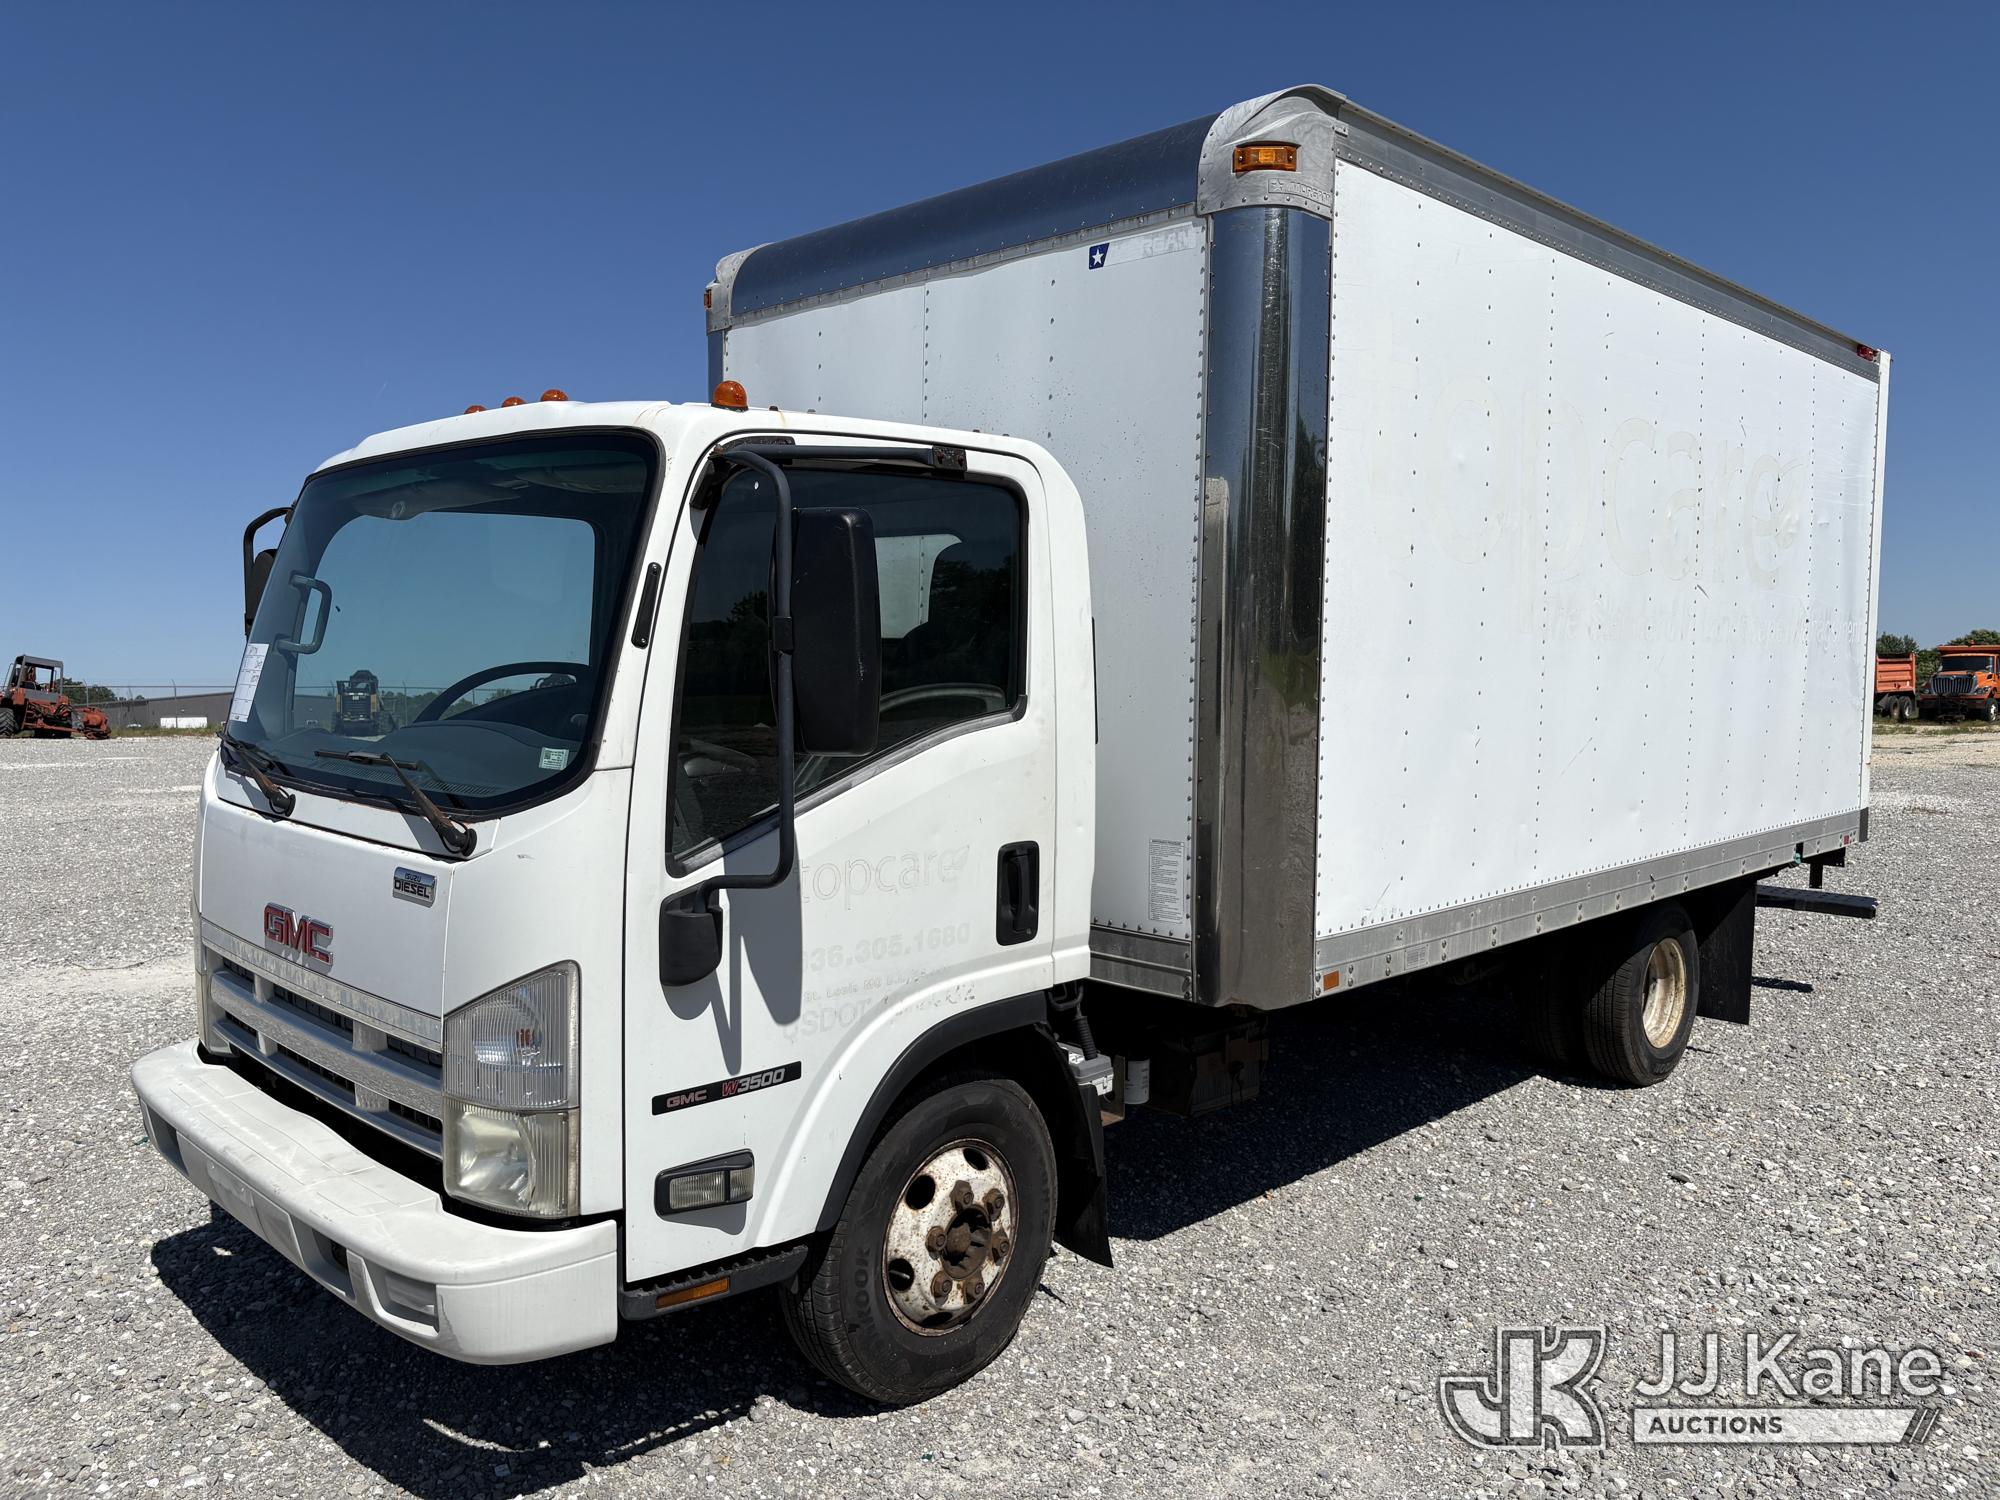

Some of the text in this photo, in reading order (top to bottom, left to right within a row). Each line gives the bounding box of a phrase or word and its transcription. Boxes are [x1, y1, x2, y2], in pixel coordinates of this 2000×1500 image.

[394, 879, 430, 899] DIESEL
[264, 902, 334, 967] GMC
[803, 922, 971, 973] 36.305.1680
[666, 1067, 786, 1109] GMC W3500
